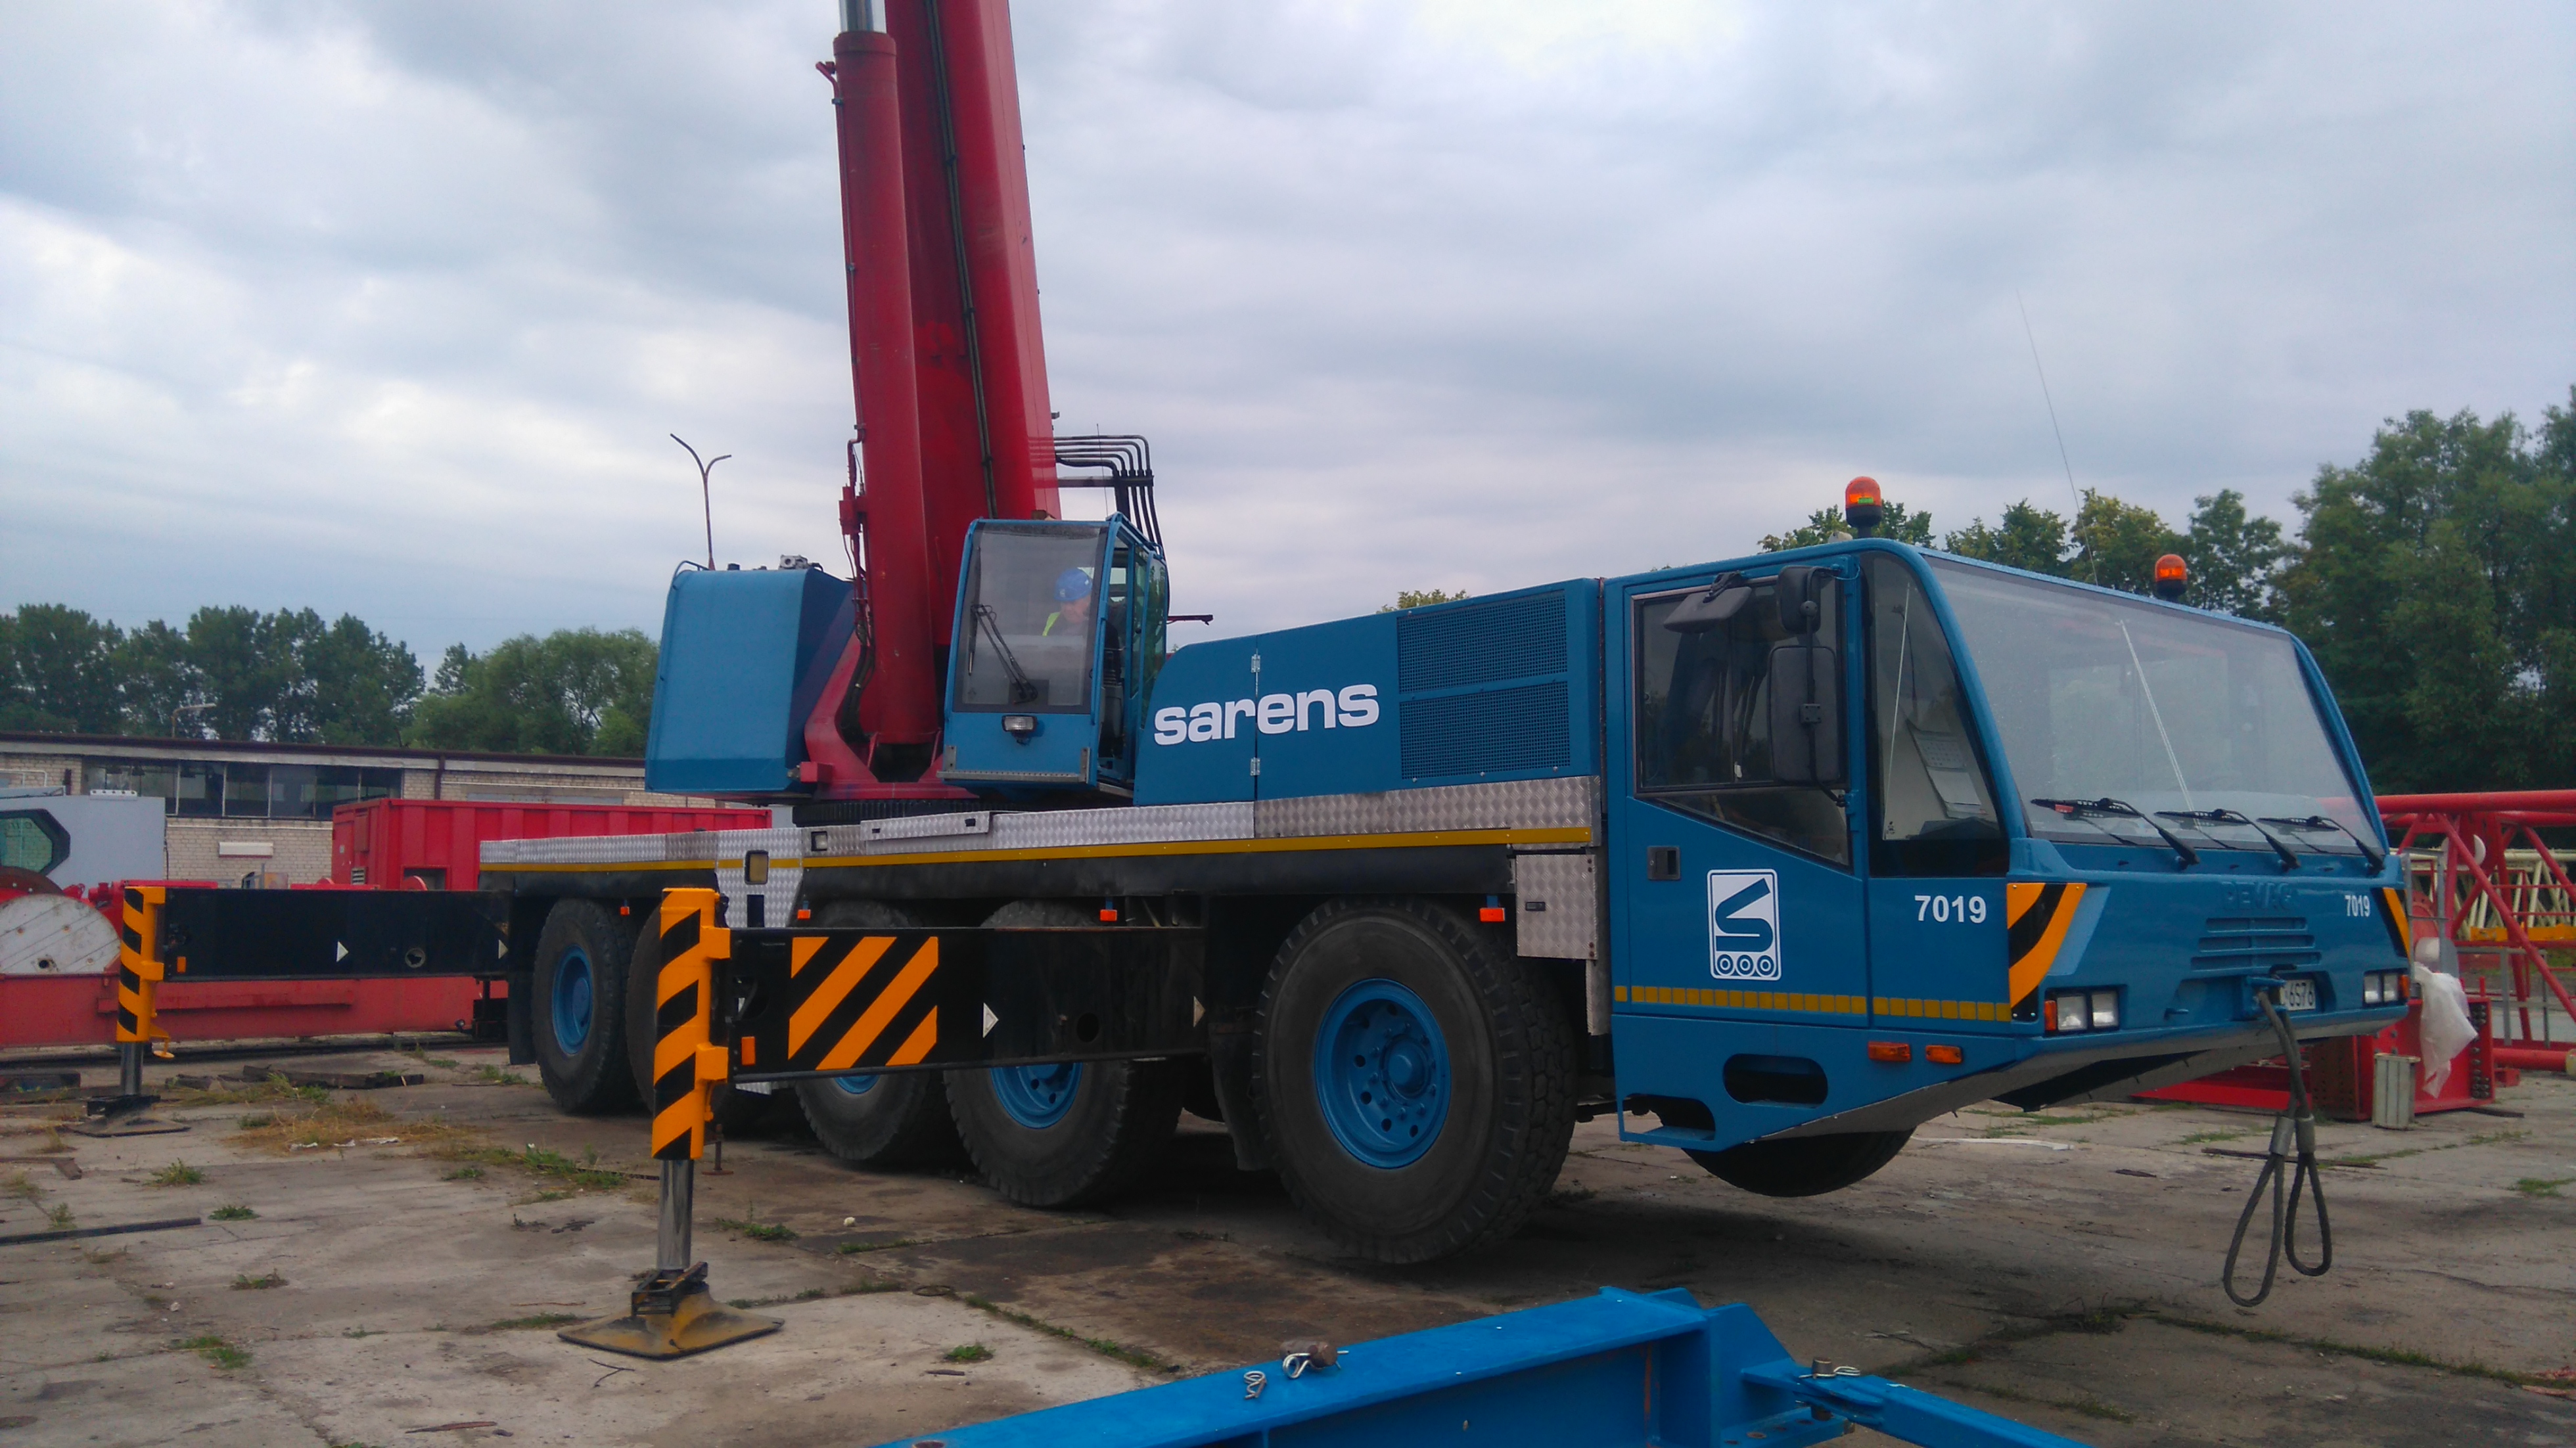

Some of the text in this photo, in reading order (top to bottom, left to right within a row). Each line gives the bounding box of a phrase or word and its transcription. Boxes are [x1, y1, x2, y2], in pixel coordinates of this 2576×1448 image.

[1155, 684, 1379, 746] sarens
[1915, 895, 1986, 924] 7019
[2345, 895, 2370, 916] 7019
